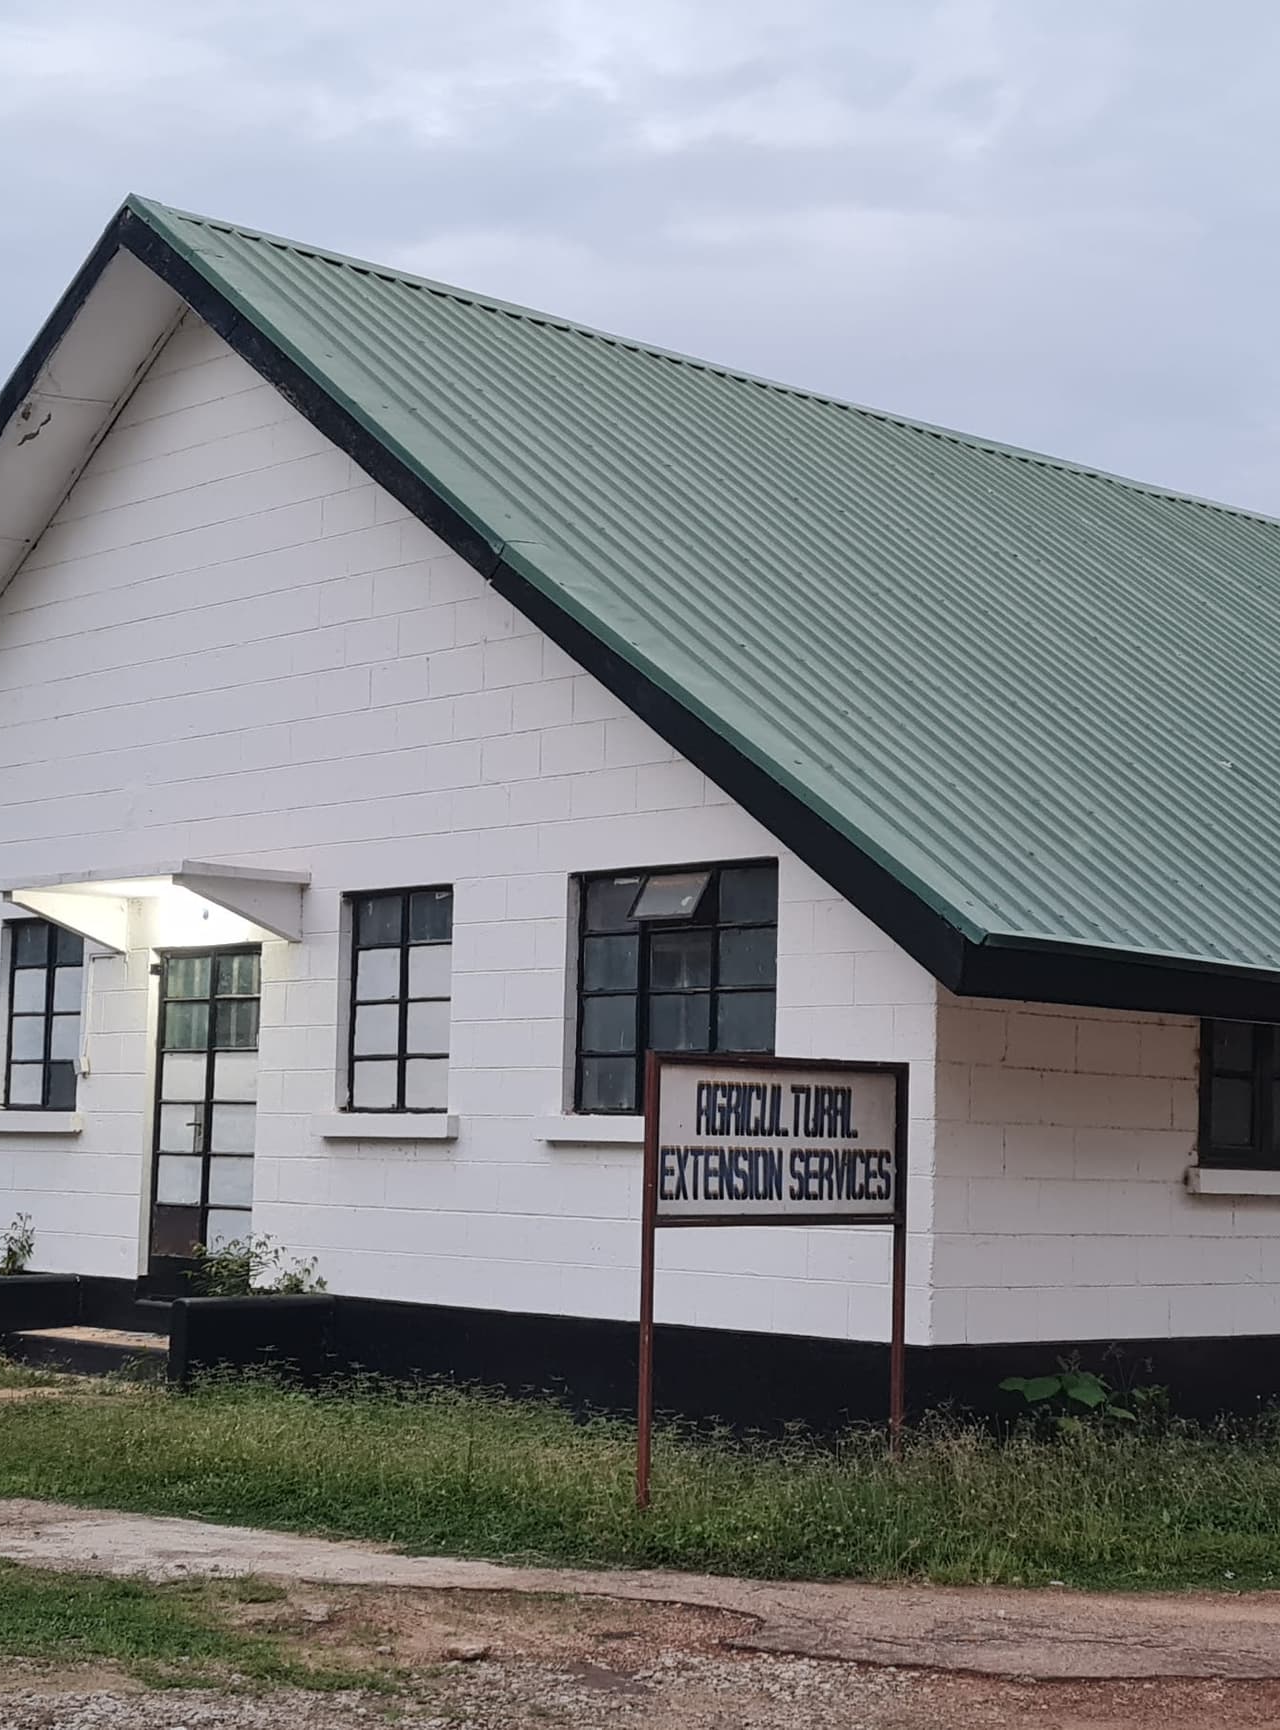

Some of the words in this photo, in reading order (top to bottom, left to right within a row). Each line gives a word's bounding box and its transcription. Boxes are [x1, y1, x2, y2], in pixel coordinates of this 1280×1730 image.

[696, 1080, 858, 1138] AGRICULTURAL
[660, 1145, 783, 1201] EXTENSION
[789, 1148, 892, 1201] SERVICES
